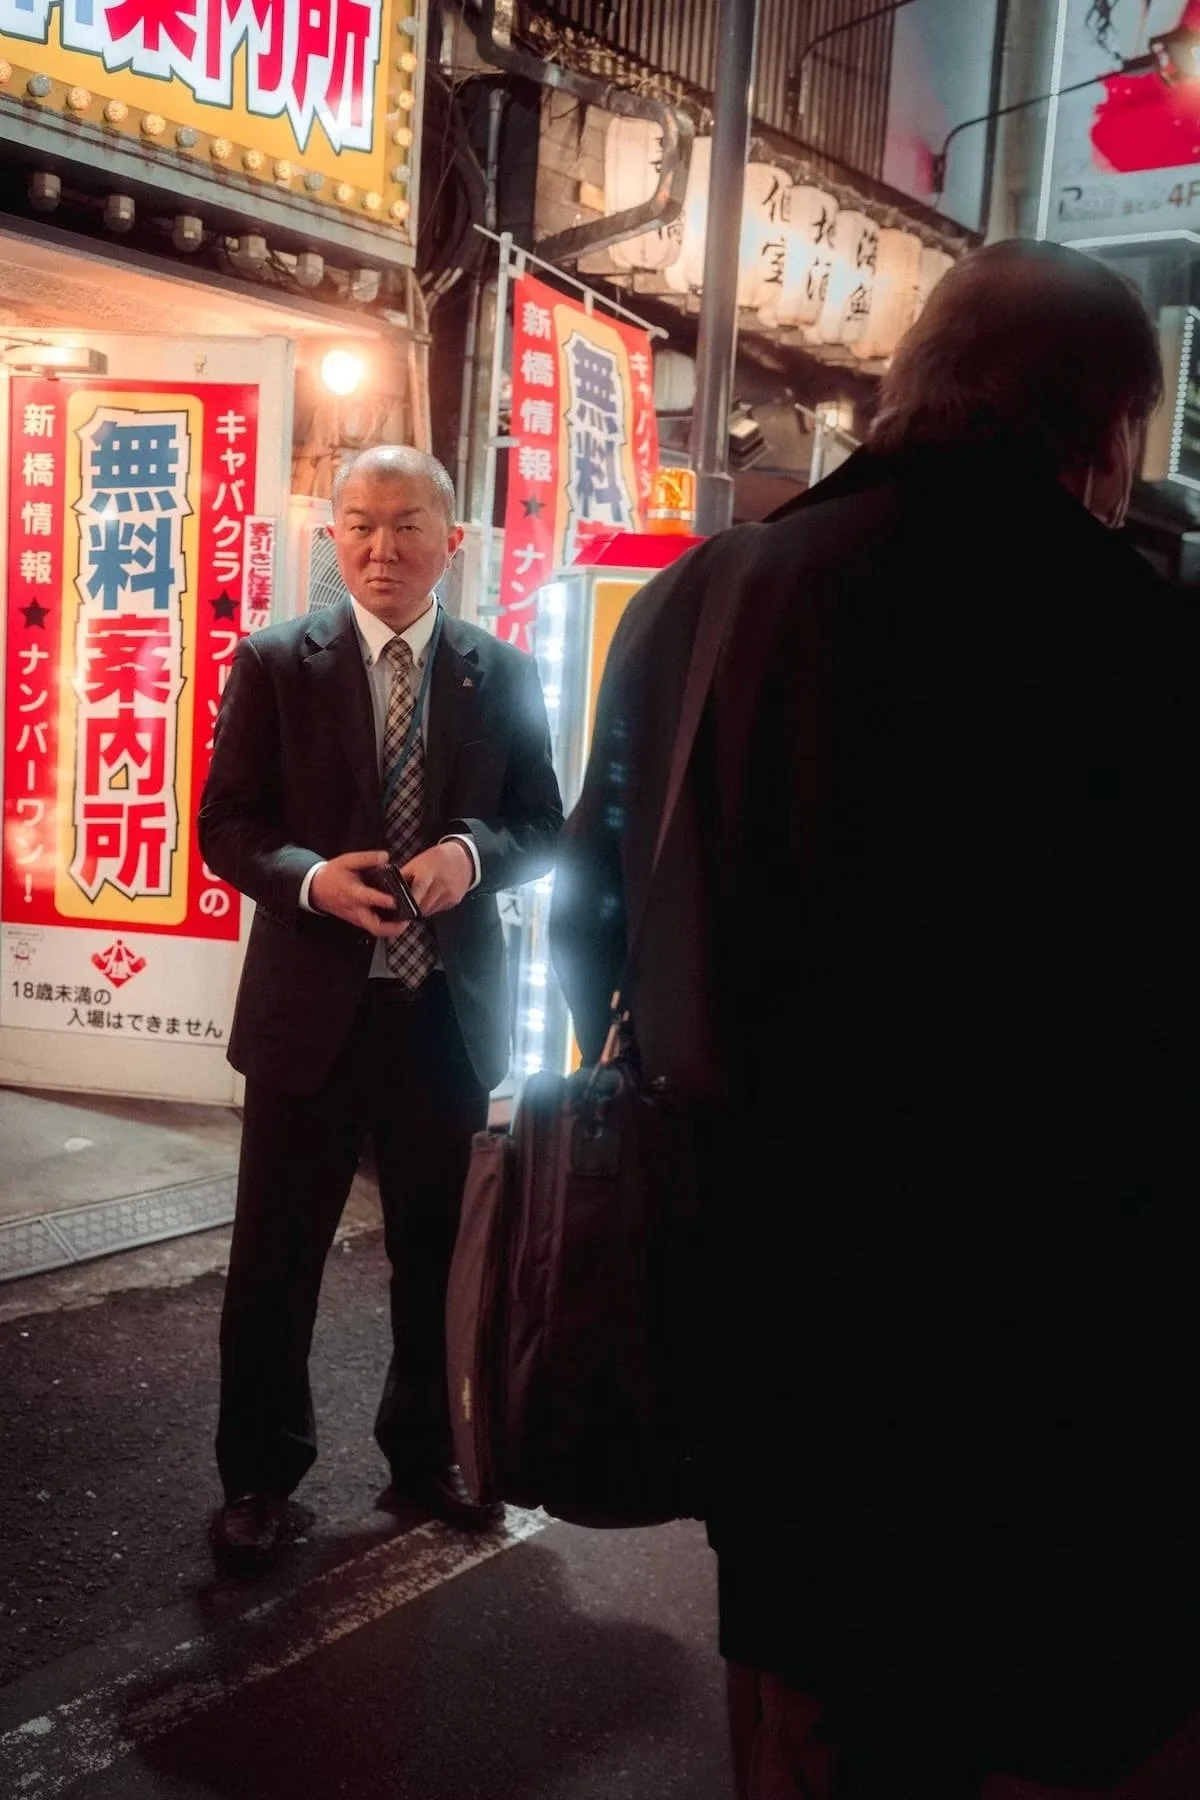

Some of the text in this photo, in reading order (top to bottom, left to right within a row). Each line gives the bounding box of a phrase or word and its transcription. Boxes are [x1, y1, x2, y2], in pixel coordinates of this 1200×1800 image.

[517, 302, 555, 482] 新橋情報
[20, 402, 56, 585] 新橋情報
[211, 409, 248, 583] キャバクラ
[80, 420, 179, 890] 無料案内所
[12, 980, 112, 1006] 18歳未満の
[67, 1007, 223, 1039] 入場はできません
